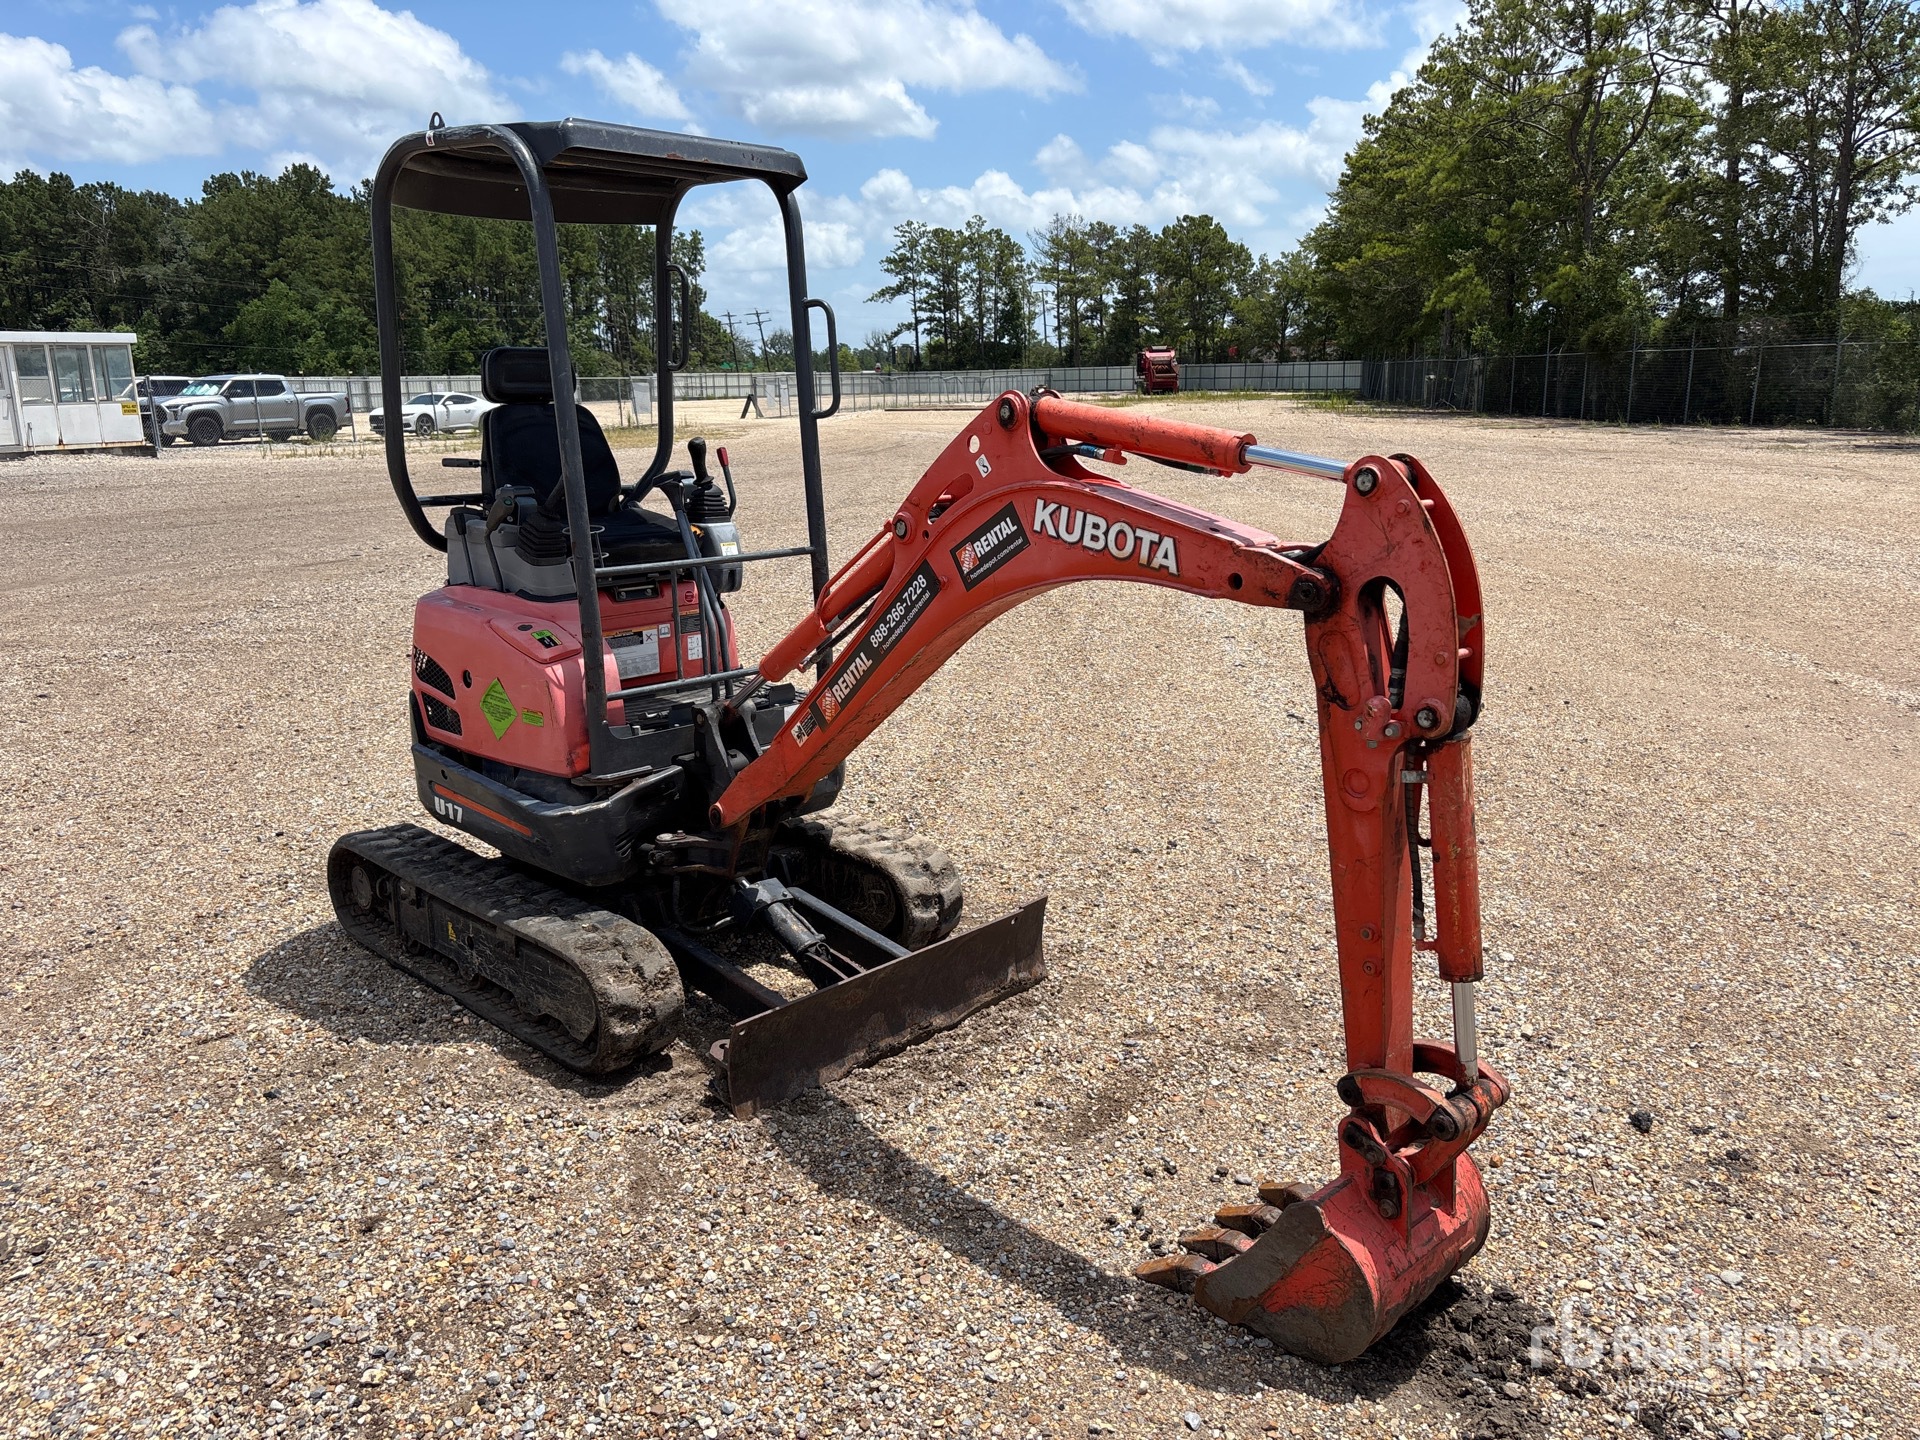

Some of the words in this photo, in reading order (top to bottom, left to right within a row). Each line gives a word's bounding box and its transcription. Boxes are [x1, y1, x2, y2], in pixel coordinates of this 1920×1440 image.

[970, 536, 1024, 580] homedepot.com/rental
[973, 516, 1018, 558] RENTAL
[1033, 498, 1179, 577] KUBOTA
[870, 574, 927, 648] 888-266-7228
[882, 590, 931, 651] homedepot.com/rental
[832, 651, 873, 704] RENTAL
[434, 795, 463, 824] U17
